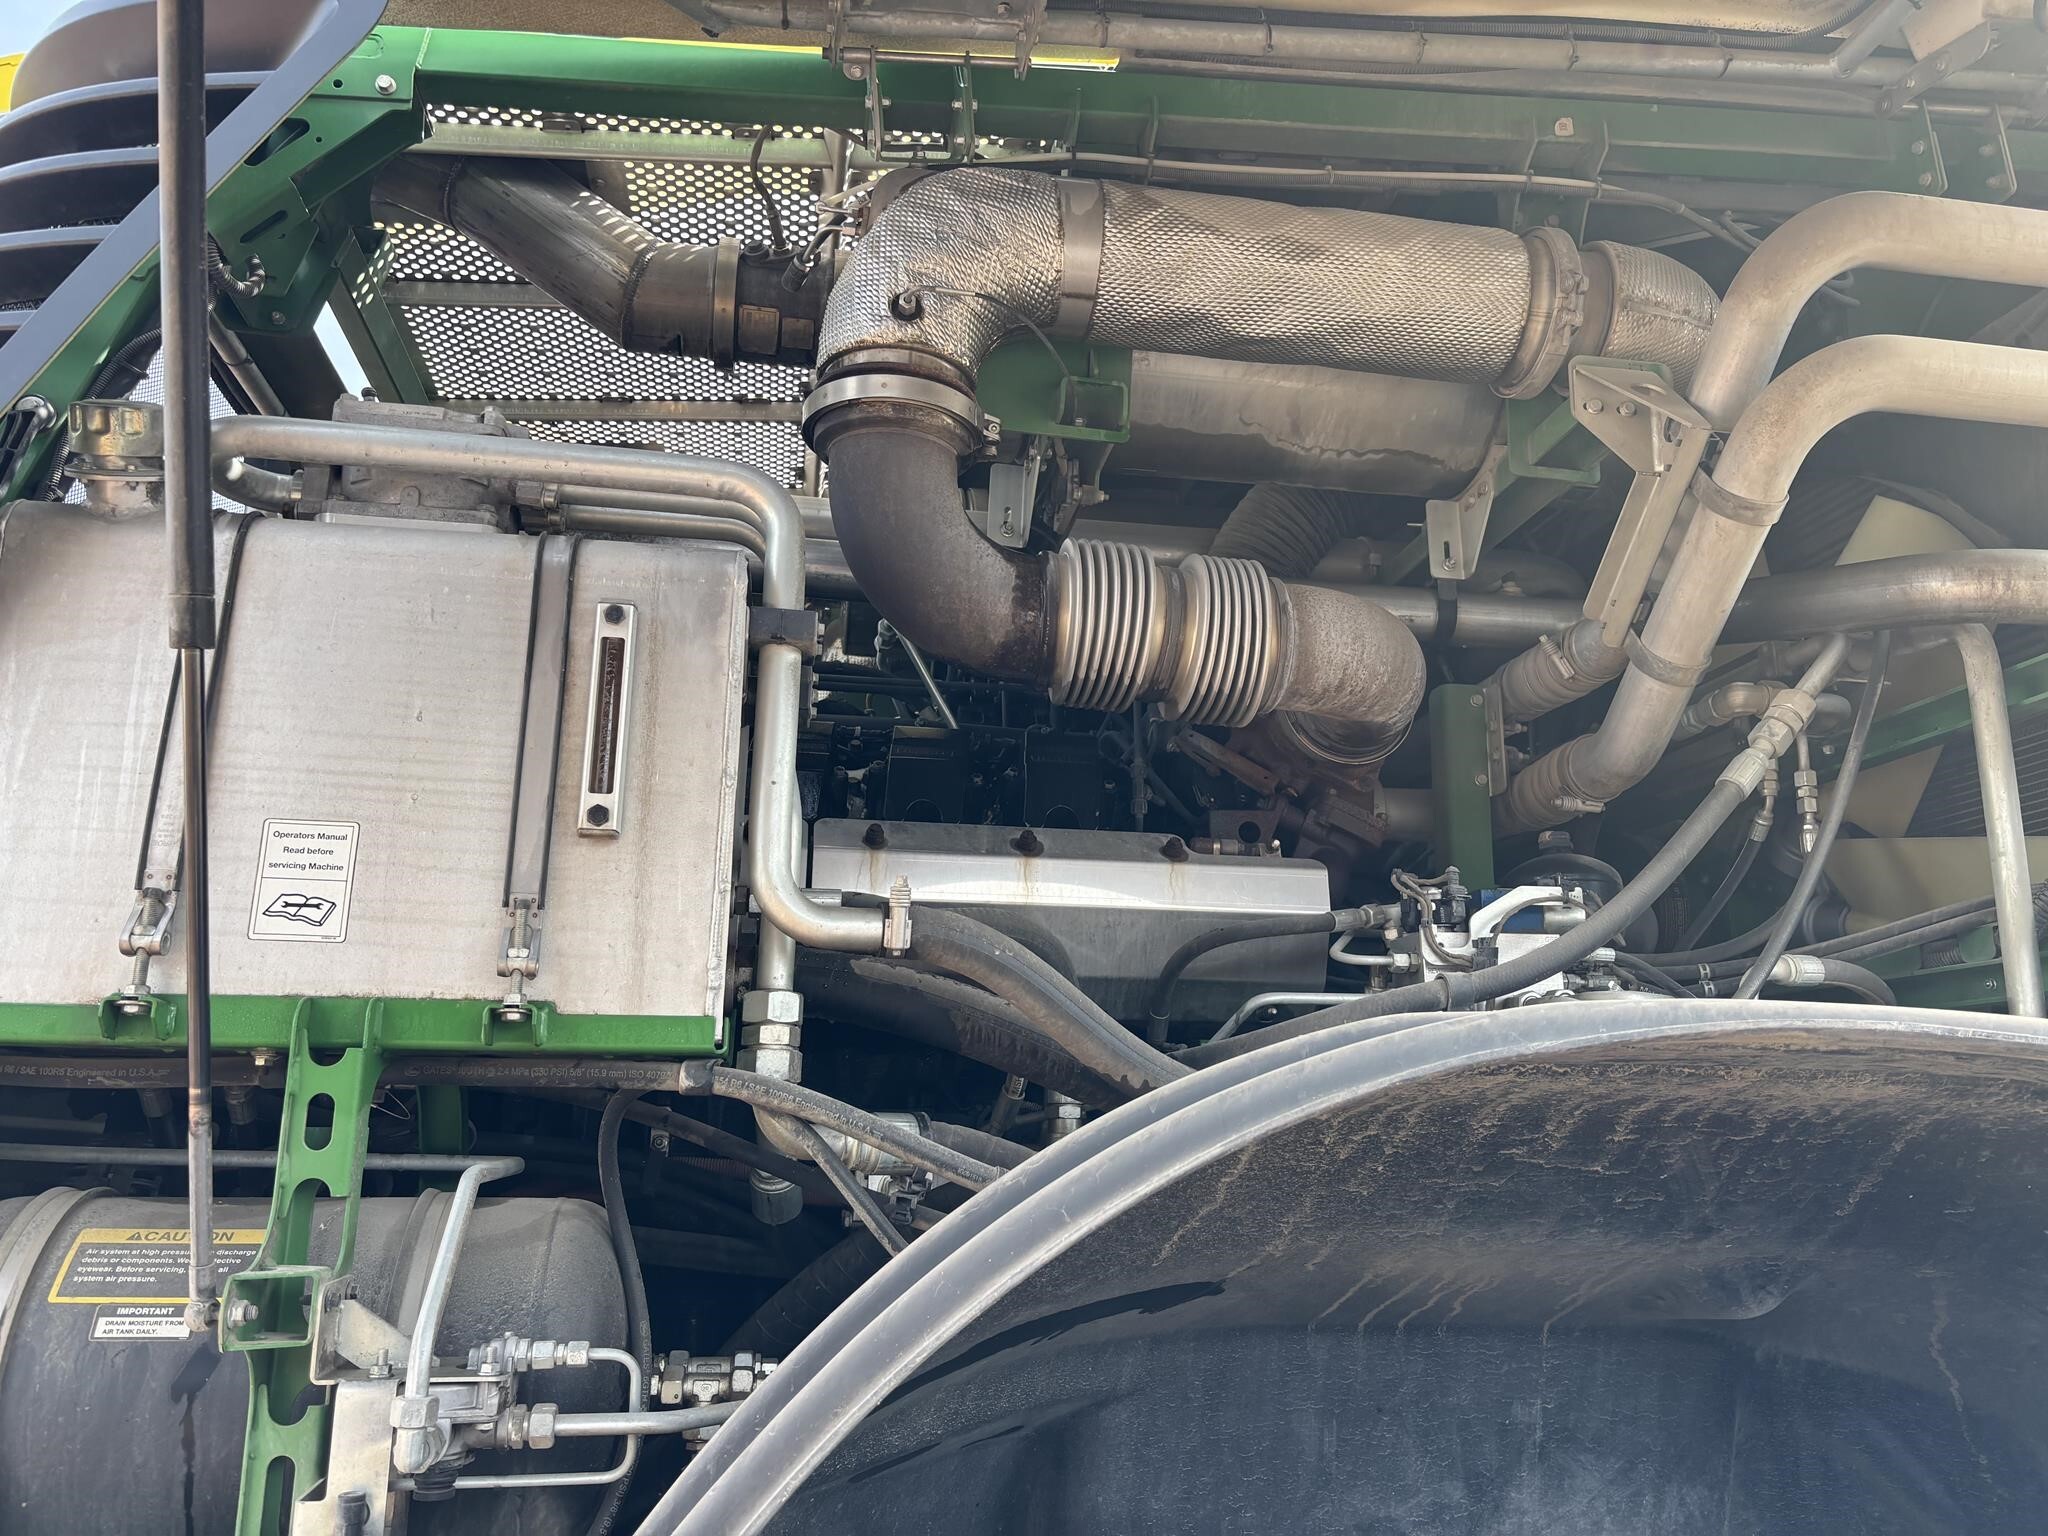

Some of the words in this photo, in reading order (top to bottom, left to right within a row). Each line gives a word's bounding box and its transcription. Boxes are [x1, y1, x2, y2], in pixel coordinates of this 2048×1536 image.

[273, 830, 315, 840] Operators
[317, 832, 348, 841] Manual
[282, 846, 305, 854] Read
[307, 847, 334, 855] before
[268, 861, 306, 871] servicing
[308, 862, 344, 871] Machine
[20, 1065, 38, 1075] SAE
[586, 1068, 607, 1079] (15.9
[608, 1070, 627, 1079] mm)
[628, 1069, 644, 1079] ISO
[748, 1082, 767, 1095] SAE
[216, 1249, 257, 1257] discharge
[121, 1257, 175, 1265] components.
[77, 1266, 114, 1274] eyewear.
[73, 1275, 104, 1283] system
[117, 1276, 158, 1284] pressure.
[116, 1307, 175, 1315] IMPORTANT
